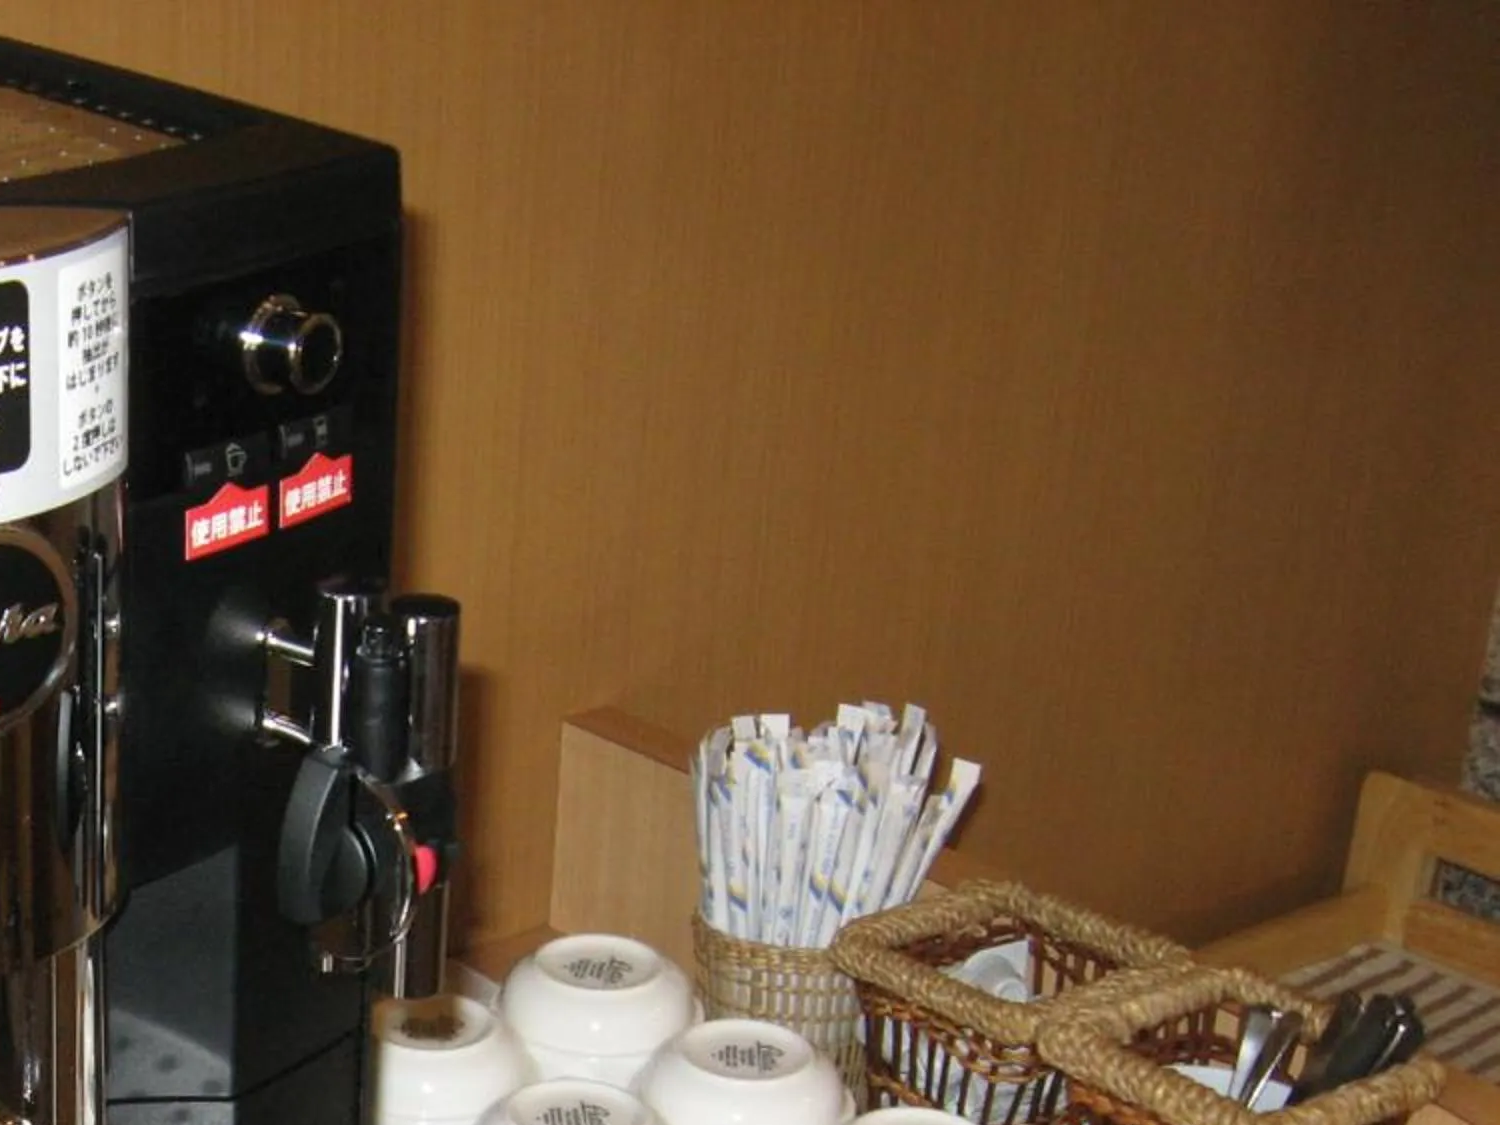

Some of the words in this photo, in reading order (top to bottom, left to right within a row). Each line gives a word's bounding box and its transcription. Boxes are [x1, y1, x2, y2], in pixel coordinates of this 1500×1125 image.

[285, 469, 348, 517] 使用禁止
[191, 501, 265, 549] 使用禁止
